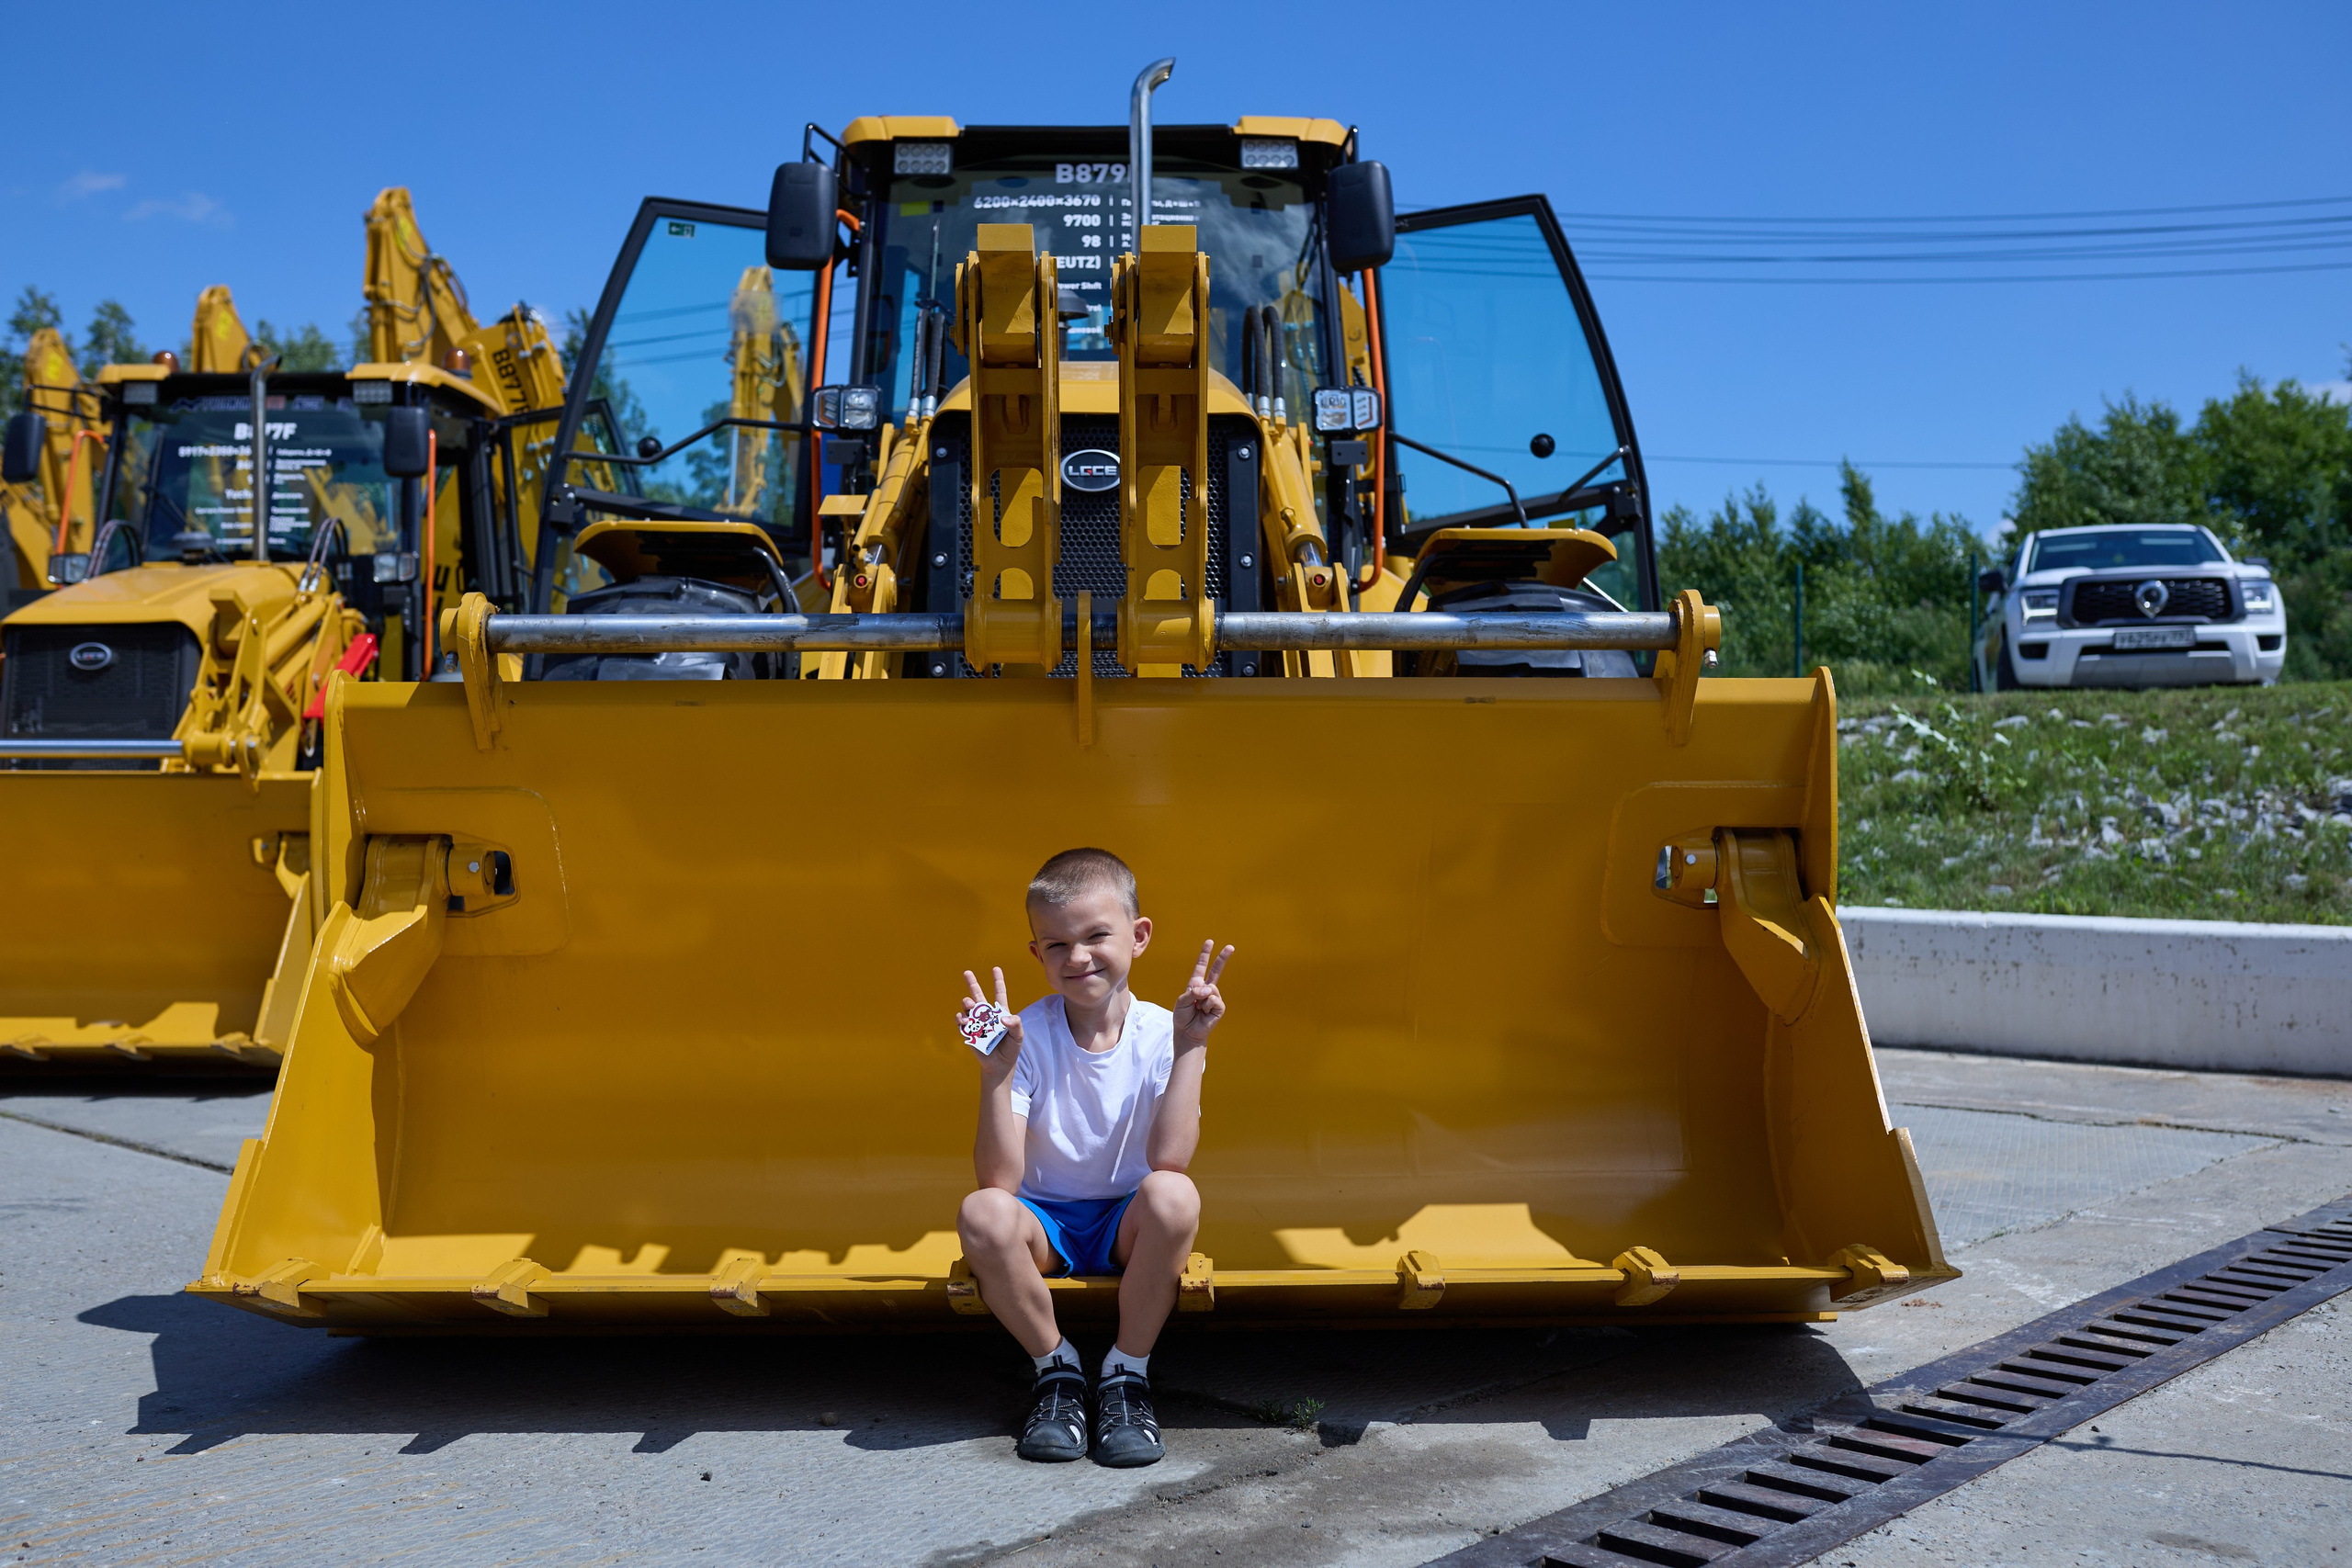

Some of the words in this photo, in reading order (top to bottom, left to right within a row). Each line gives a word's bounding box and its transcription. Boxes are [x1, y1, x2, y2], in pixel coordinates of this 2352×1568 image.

[1056, 163, 1131, 184] B879
[1063, 214, 1102, 228] 9700
[1081, 234, 1102, 248] 98
[1057, 254, 1102, 270] EUTZ)
[1068, 465, 1117, 476] LGCE
